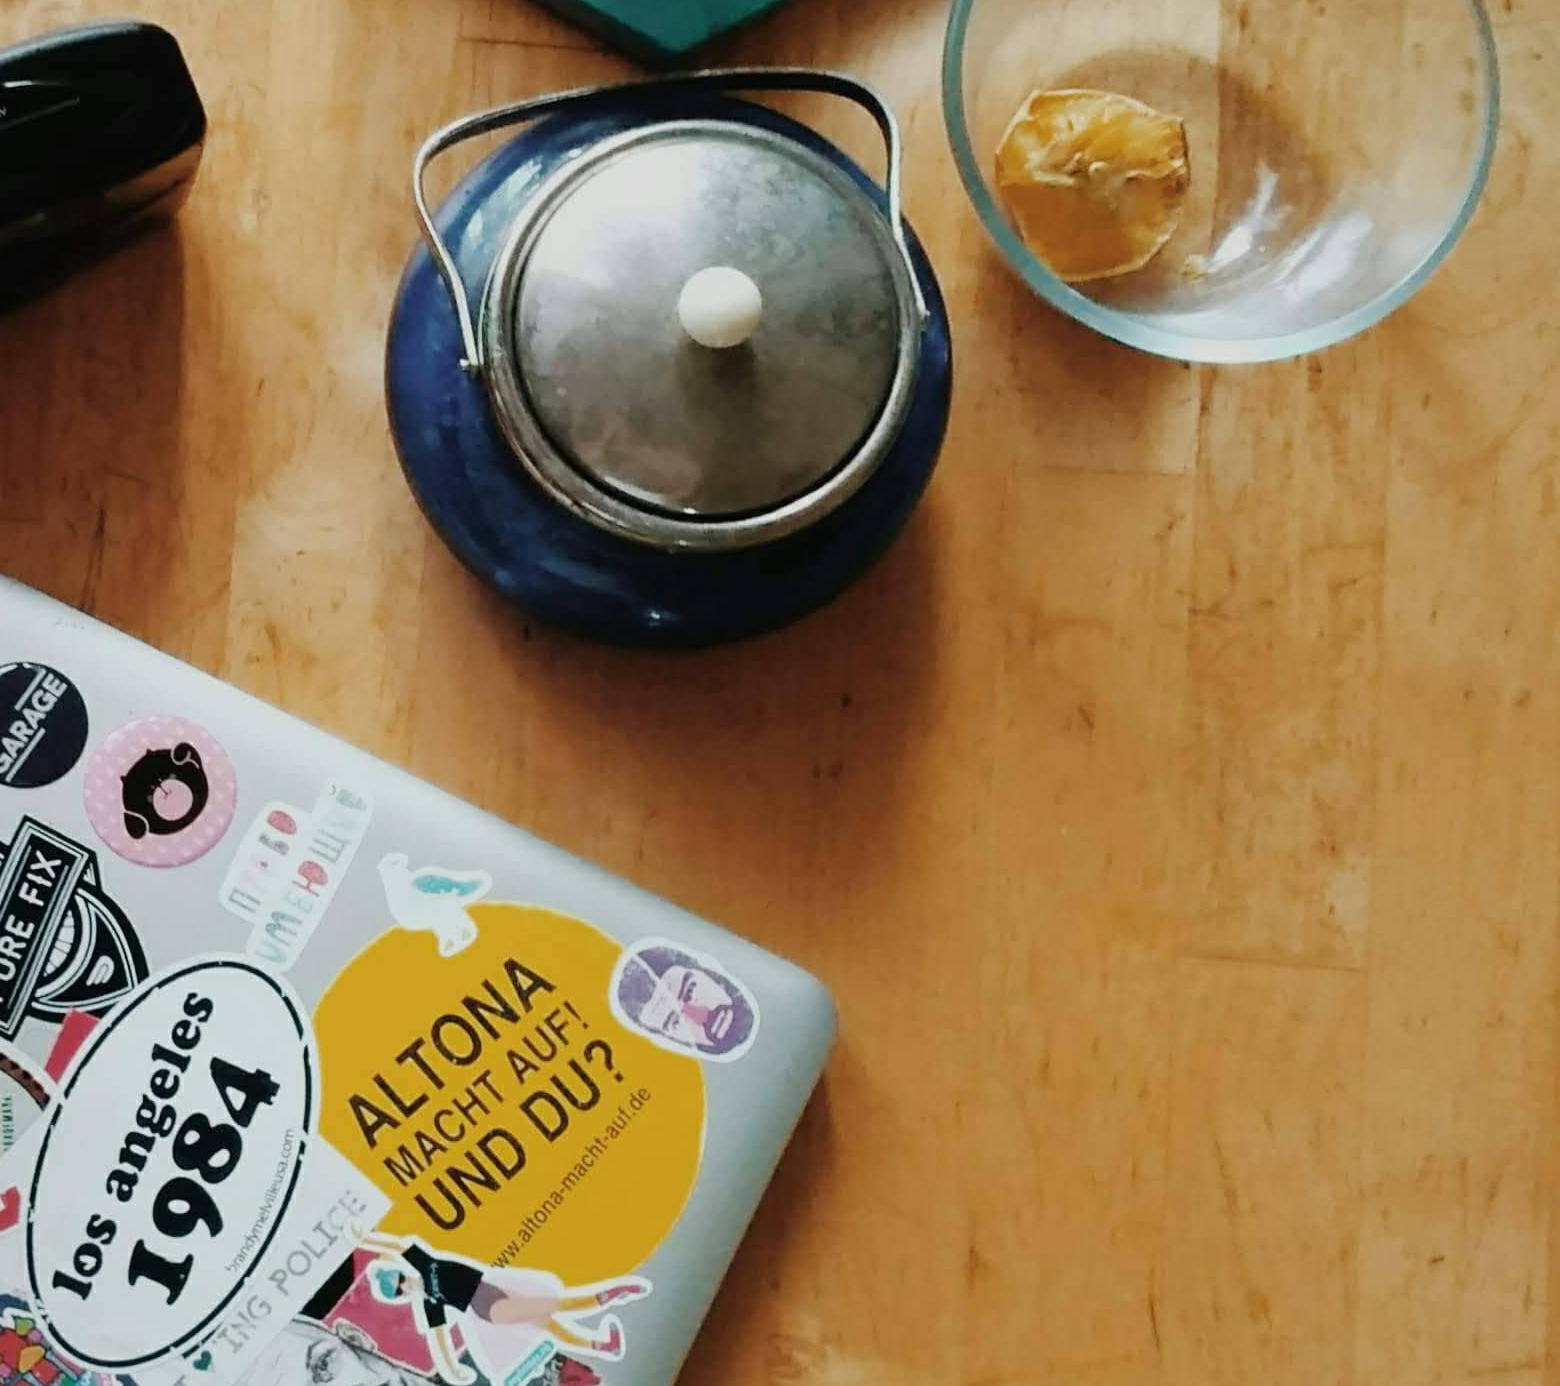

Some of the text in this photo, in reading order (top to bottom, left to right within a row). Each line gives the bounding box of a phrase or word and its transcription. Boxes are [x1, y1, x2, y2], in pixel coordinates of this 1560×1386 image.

[19, 851, 61, 906] FIX
[52, 993, 214, 1301] los angeles
[345, 958, 557, 1150] ALTONA
[383, 1000, 591, 1187] MACHT AUF!
[415, 1038, 627, 1232] UND DU?
[129, 1055, 281, 1306] 1984
[224, 1128, 294, 1275] brandymelvilleusa.com
[269, 1191, 365, 1295] POLICE
